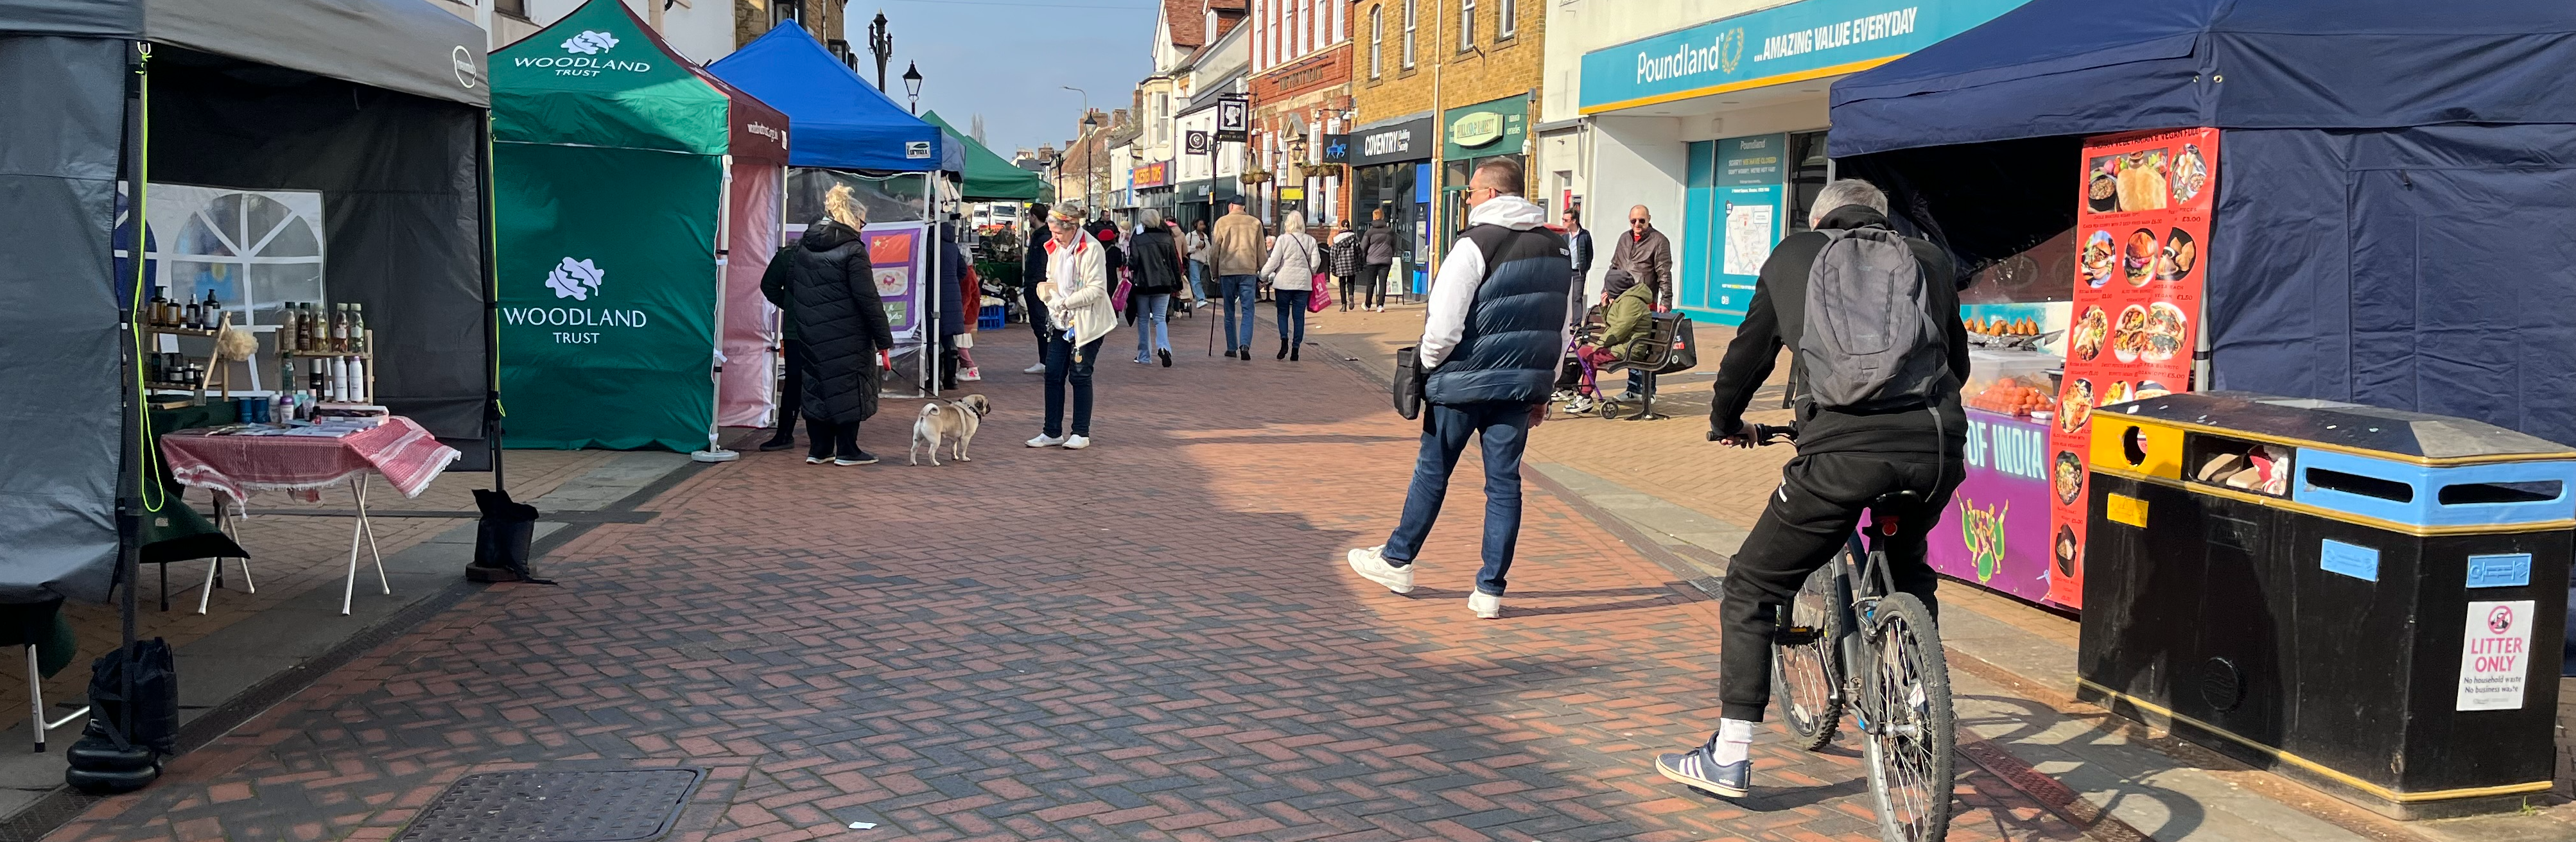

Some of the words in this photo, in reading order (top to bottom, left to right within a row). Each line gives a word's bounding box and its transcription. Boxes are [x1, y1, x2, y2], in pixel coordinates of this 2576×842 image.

[1815, 21, 1851, 51] VALUE
[1852, 6, 1918, 44] EVERYDAY
[514, 57, 650, 73] WOODLAND
[1637, 36, 1719, 84] Poundland
[1364, 131, 1398, 157] COVENTRY
[2161, 131, 2183, 141] VEGAN
[503, 307, 647, 328] WOODLAND
[552, 332, 600, 344] TRUST
[1967, 420, 1987, 467] OF
[1992, 424, 2046, 480] INDIA
[2471, 637, 2523, 654] LITTER
[2475, 655, 2516, 673] ONLY
[2473, 675, 2504, 684] household
